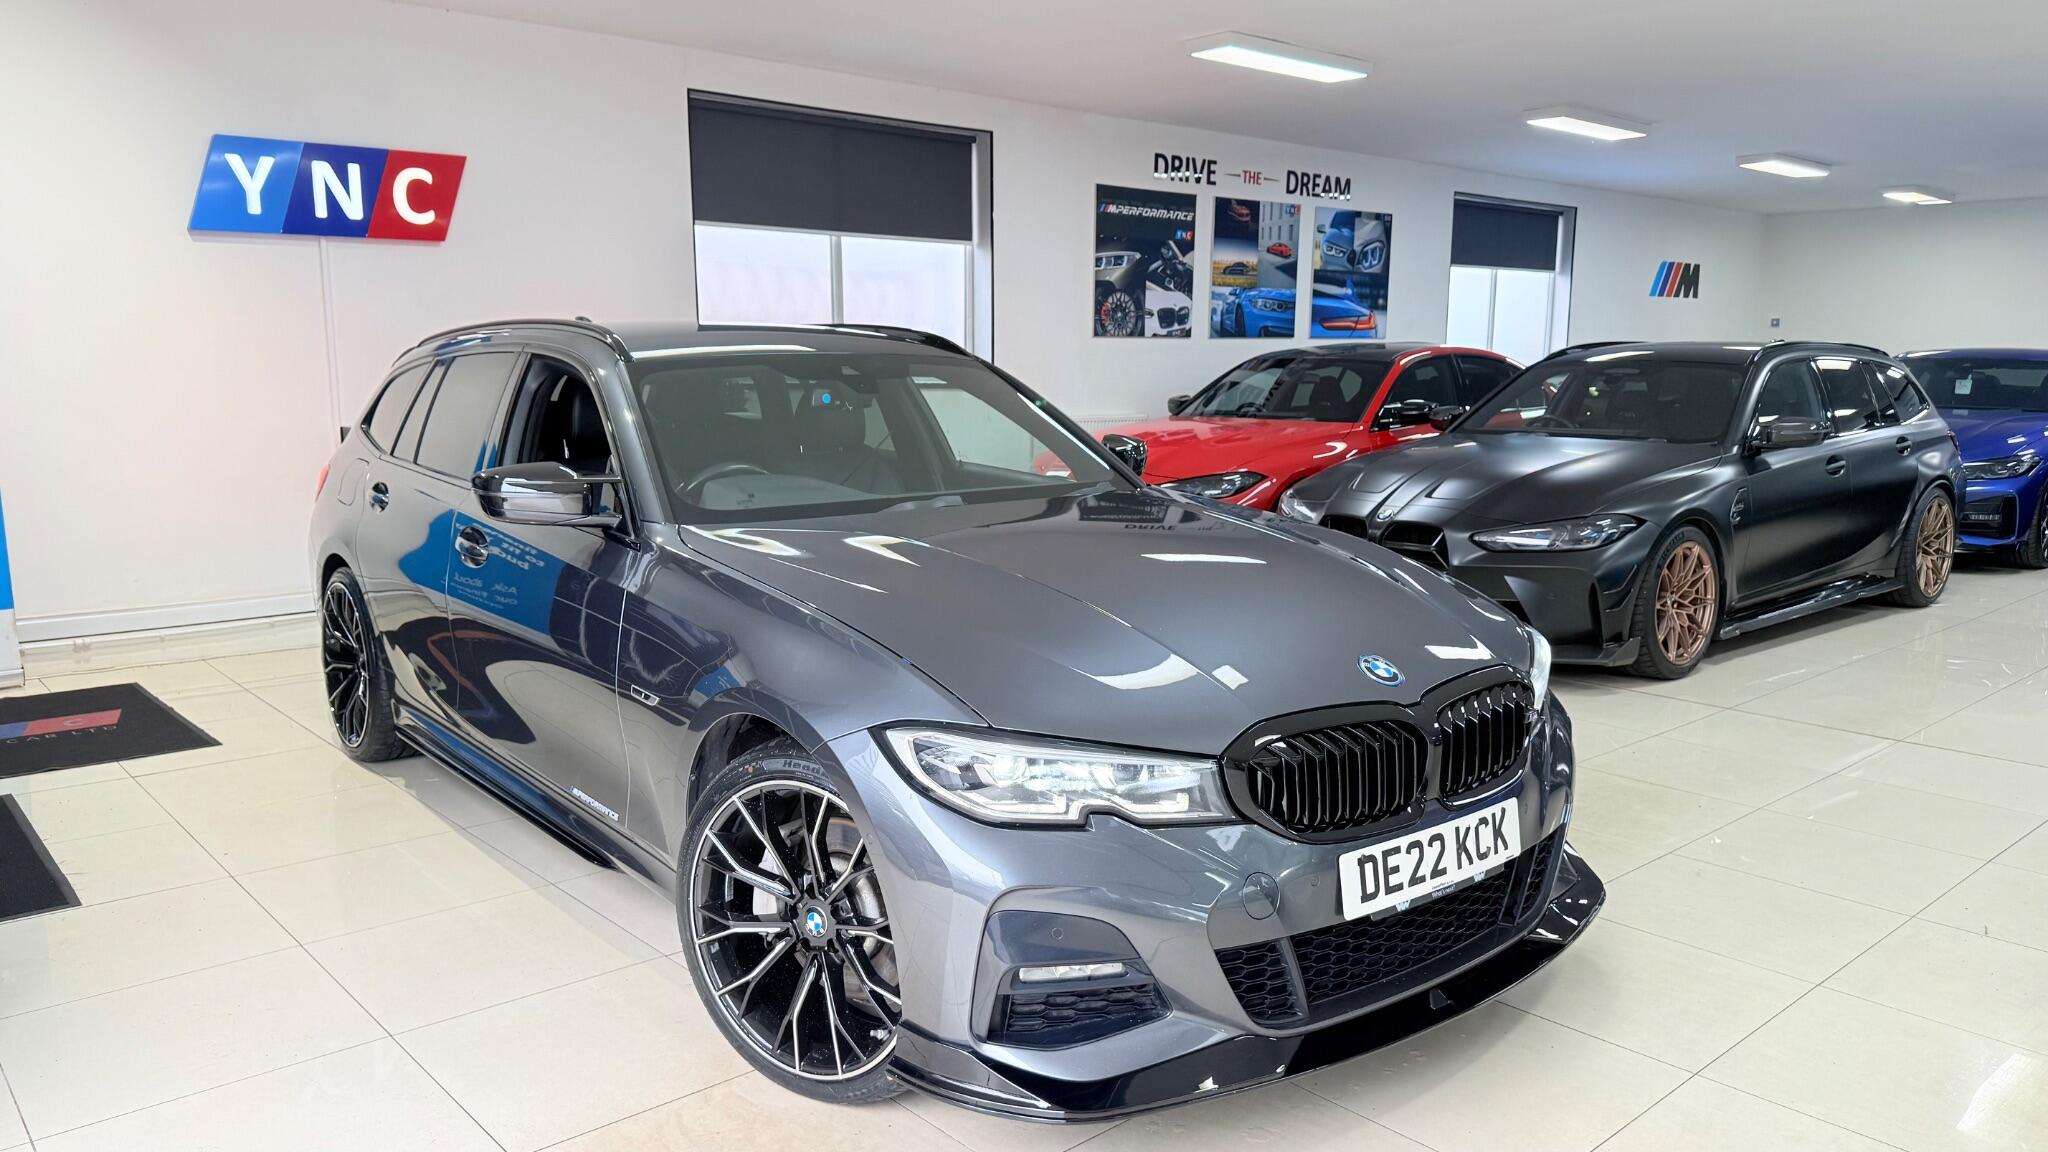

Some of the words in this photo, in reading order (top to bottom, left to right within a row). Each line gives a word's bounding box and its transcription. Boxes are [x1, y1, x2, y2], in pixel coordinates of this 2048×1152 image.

[224, 153, 436, 225] YNC
[1154, 152, 1217, 186] DRIVE
[1242, 170, 1262, 186] THE
[1286, 169, 1352, 203] DREAM
[1357, 832, 1448, 904] DE22
[1455, 806, 1510, 871] KCK
